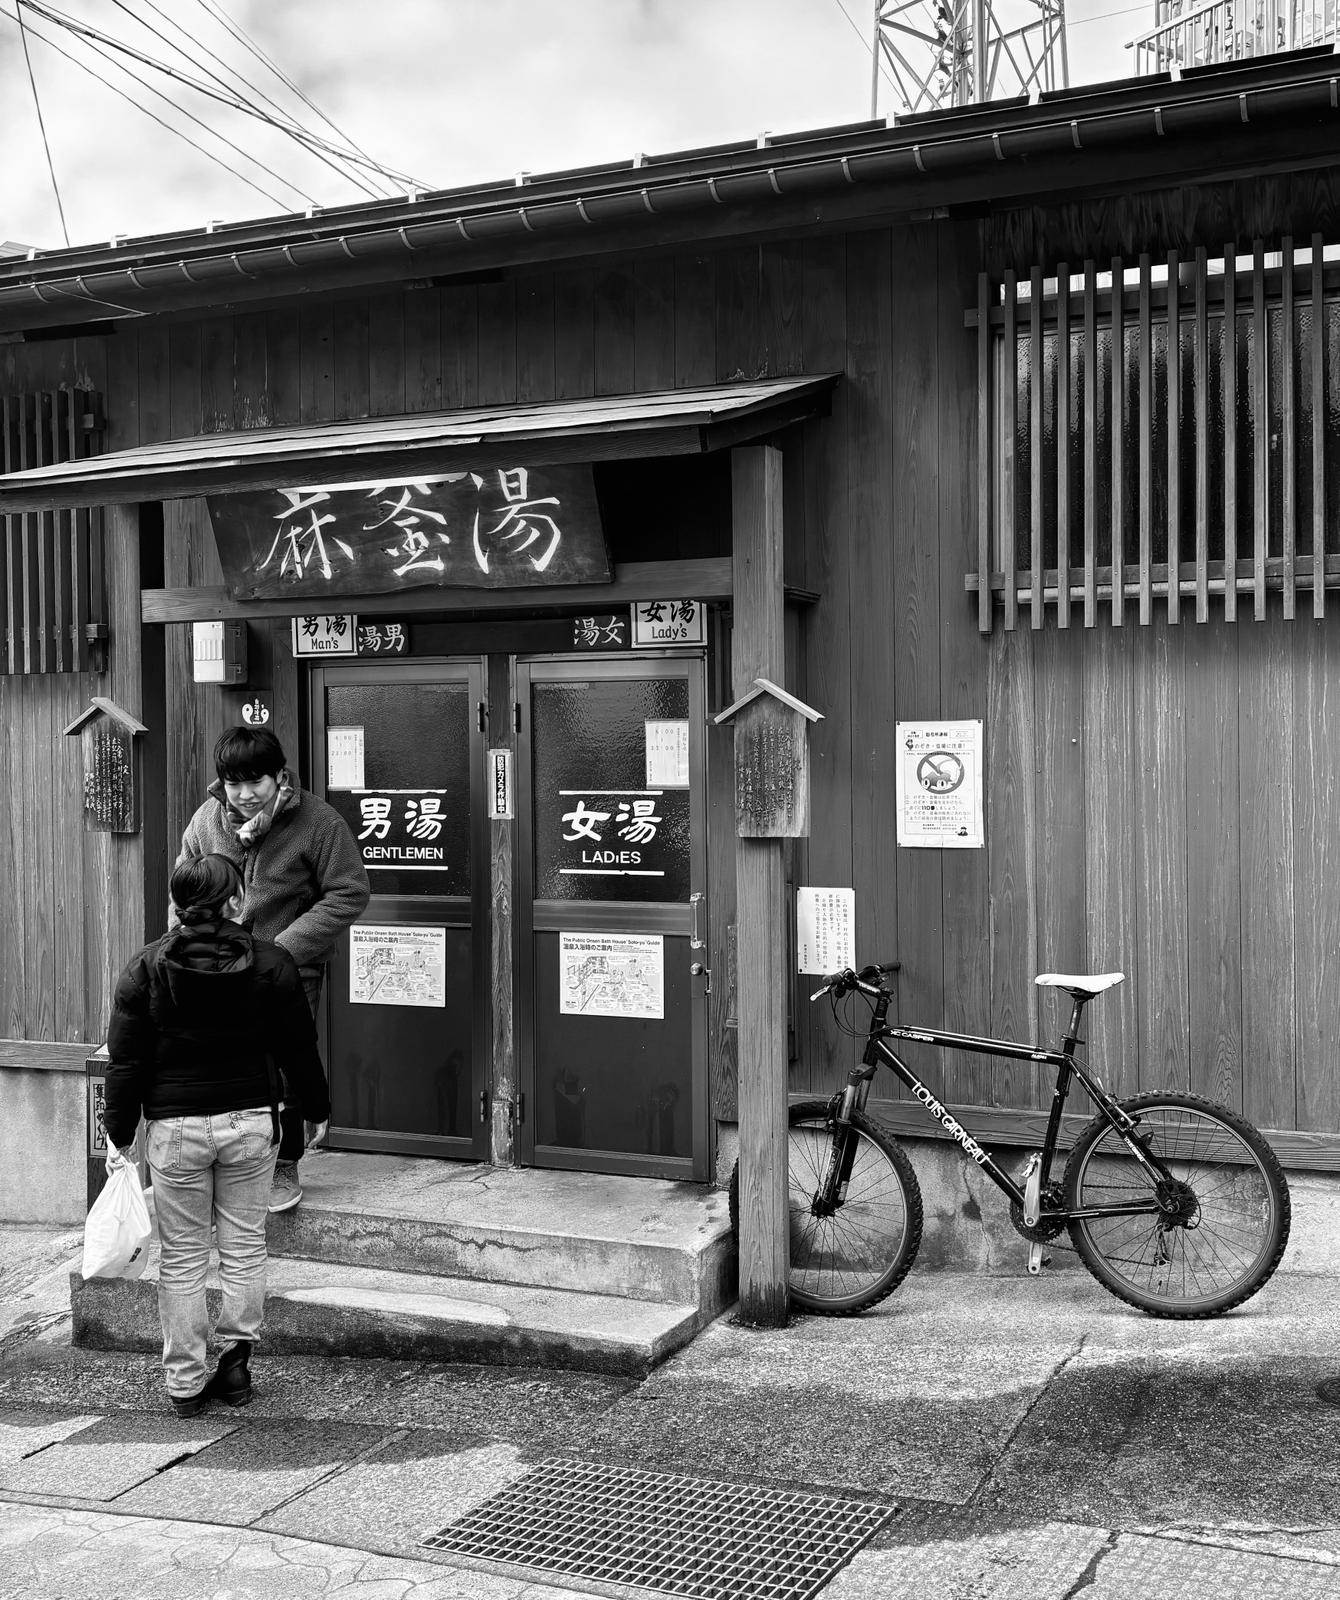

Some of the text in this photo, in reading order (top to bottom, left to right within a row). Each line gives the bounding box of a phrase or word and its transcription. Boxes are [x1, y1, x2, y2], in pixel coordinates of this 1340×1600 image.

[643, 601, 696, 624] 女湯
[301, 614, 347, 637] 男湯
[652, 622, 688, 642] Lady's
[311, 637, 339, 650] Man's
[358, 797, 447, 840] 男湯
[562, 800, 663, 844] 女湯
[363, 846, 443, 859] GENTLEMEN
[582, 850, 641, 864] LADIES
[901, 1032, 935, 1042] CASPER
[912, 1082, 990, 1164] LOUIS GARNEAU
